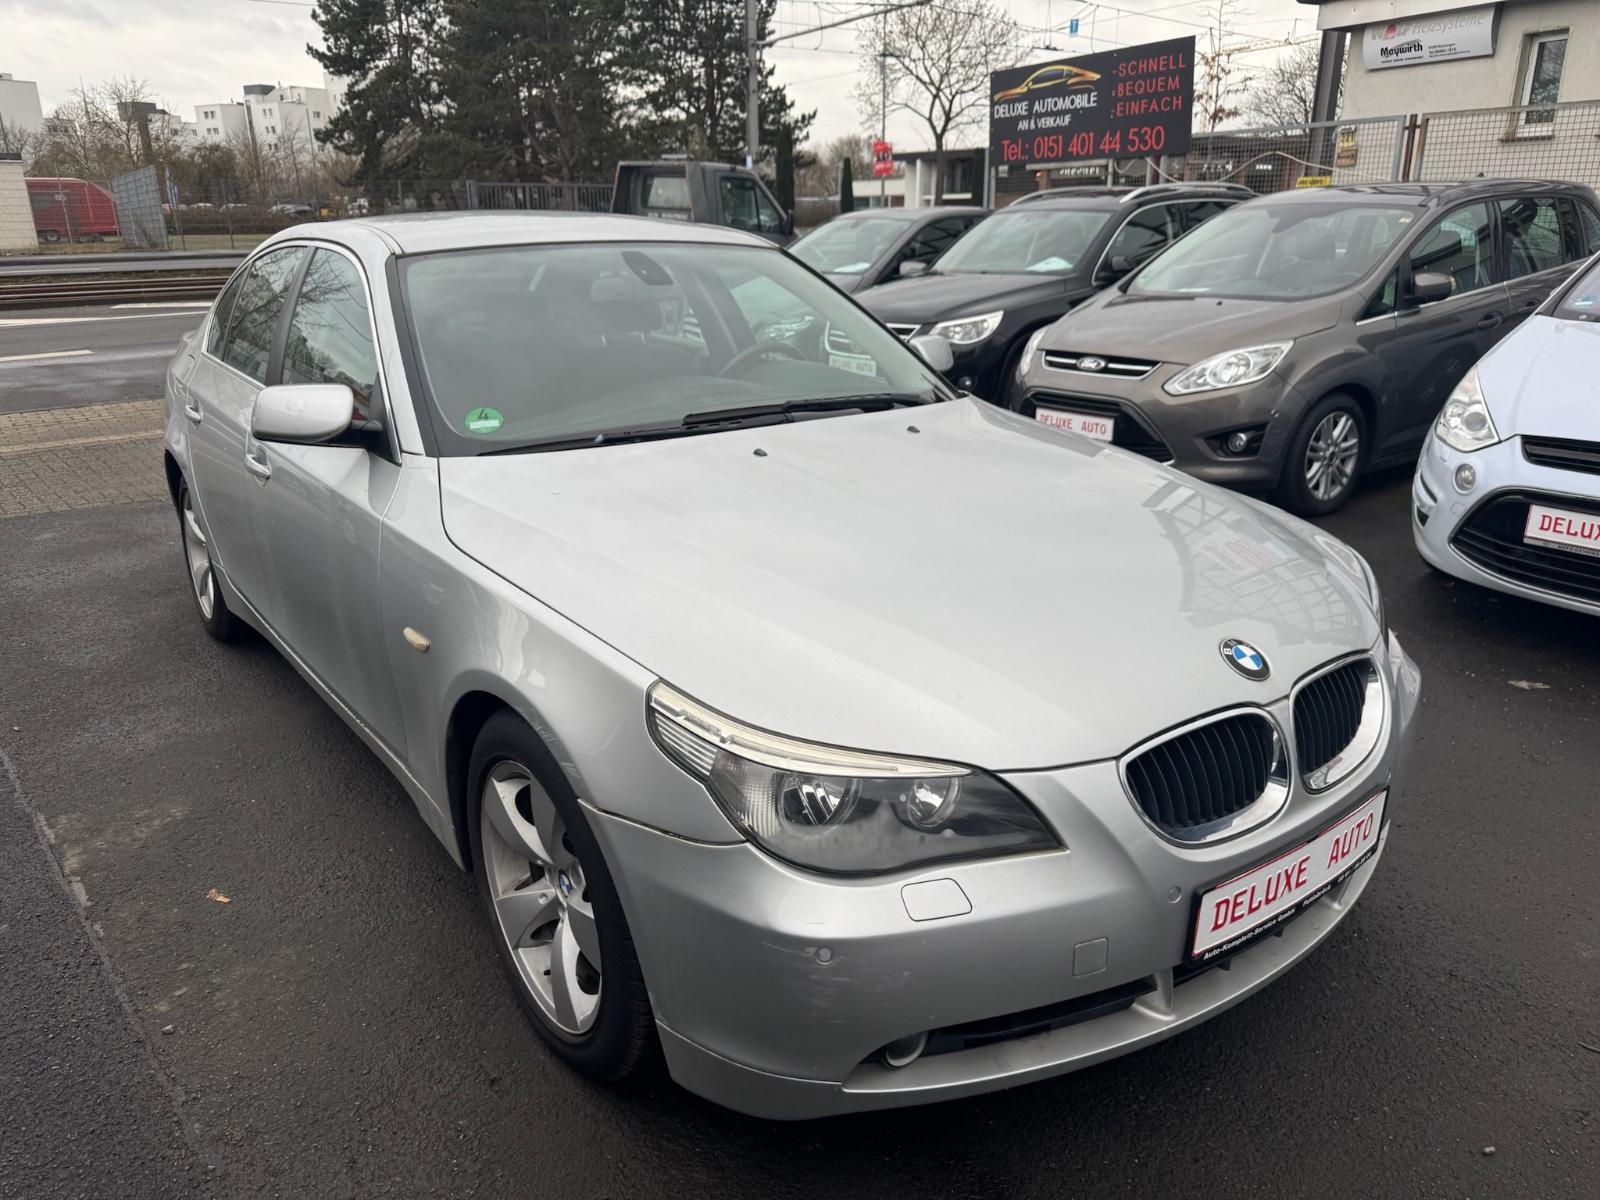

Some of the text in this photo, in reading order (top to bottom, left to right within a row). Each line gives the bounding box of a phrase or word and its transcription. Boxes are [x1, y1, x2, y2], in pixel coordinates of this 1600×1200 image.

[1380, 42, 1423, 57] Meywirth
[993, 91, 1098, 119] DELUXE AUTOMOBILE
[1017, 114, 1072, 131] AN & VERKAUF
[1002, 125, 1165, 161] Tel.: 0151 401 44 530
[1040, 414, 1106, 435] DELUXE AUTO
[1209, 855, 1311, 932] DELUXE
[1327, 812, 1374, 870] AUTO
